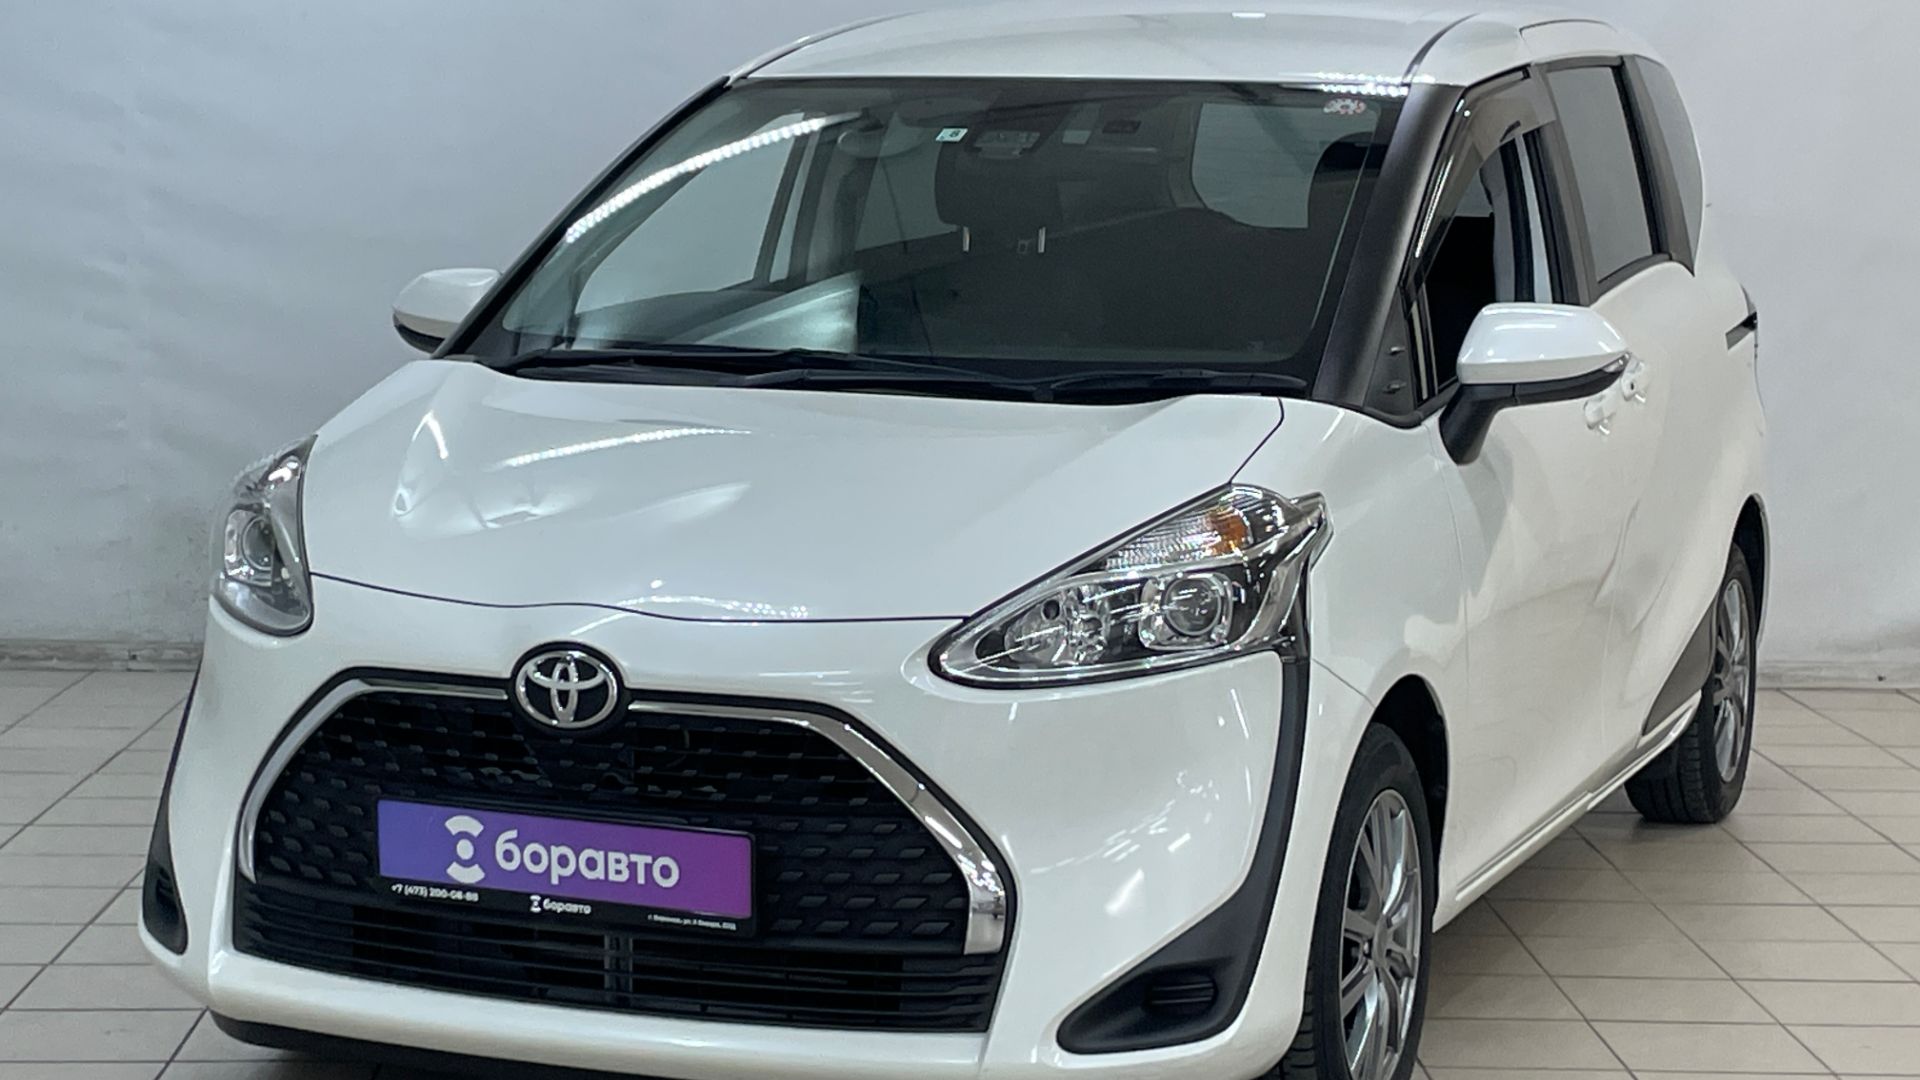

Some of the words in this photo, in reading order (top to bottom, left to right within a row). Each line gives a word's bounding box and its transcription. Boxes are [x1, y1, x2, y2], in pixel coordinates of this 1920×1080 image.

[495, 829, 680, 888] боравто
[391, 883, 404, 894] +7
[542, 898, 592, 914] боравто
